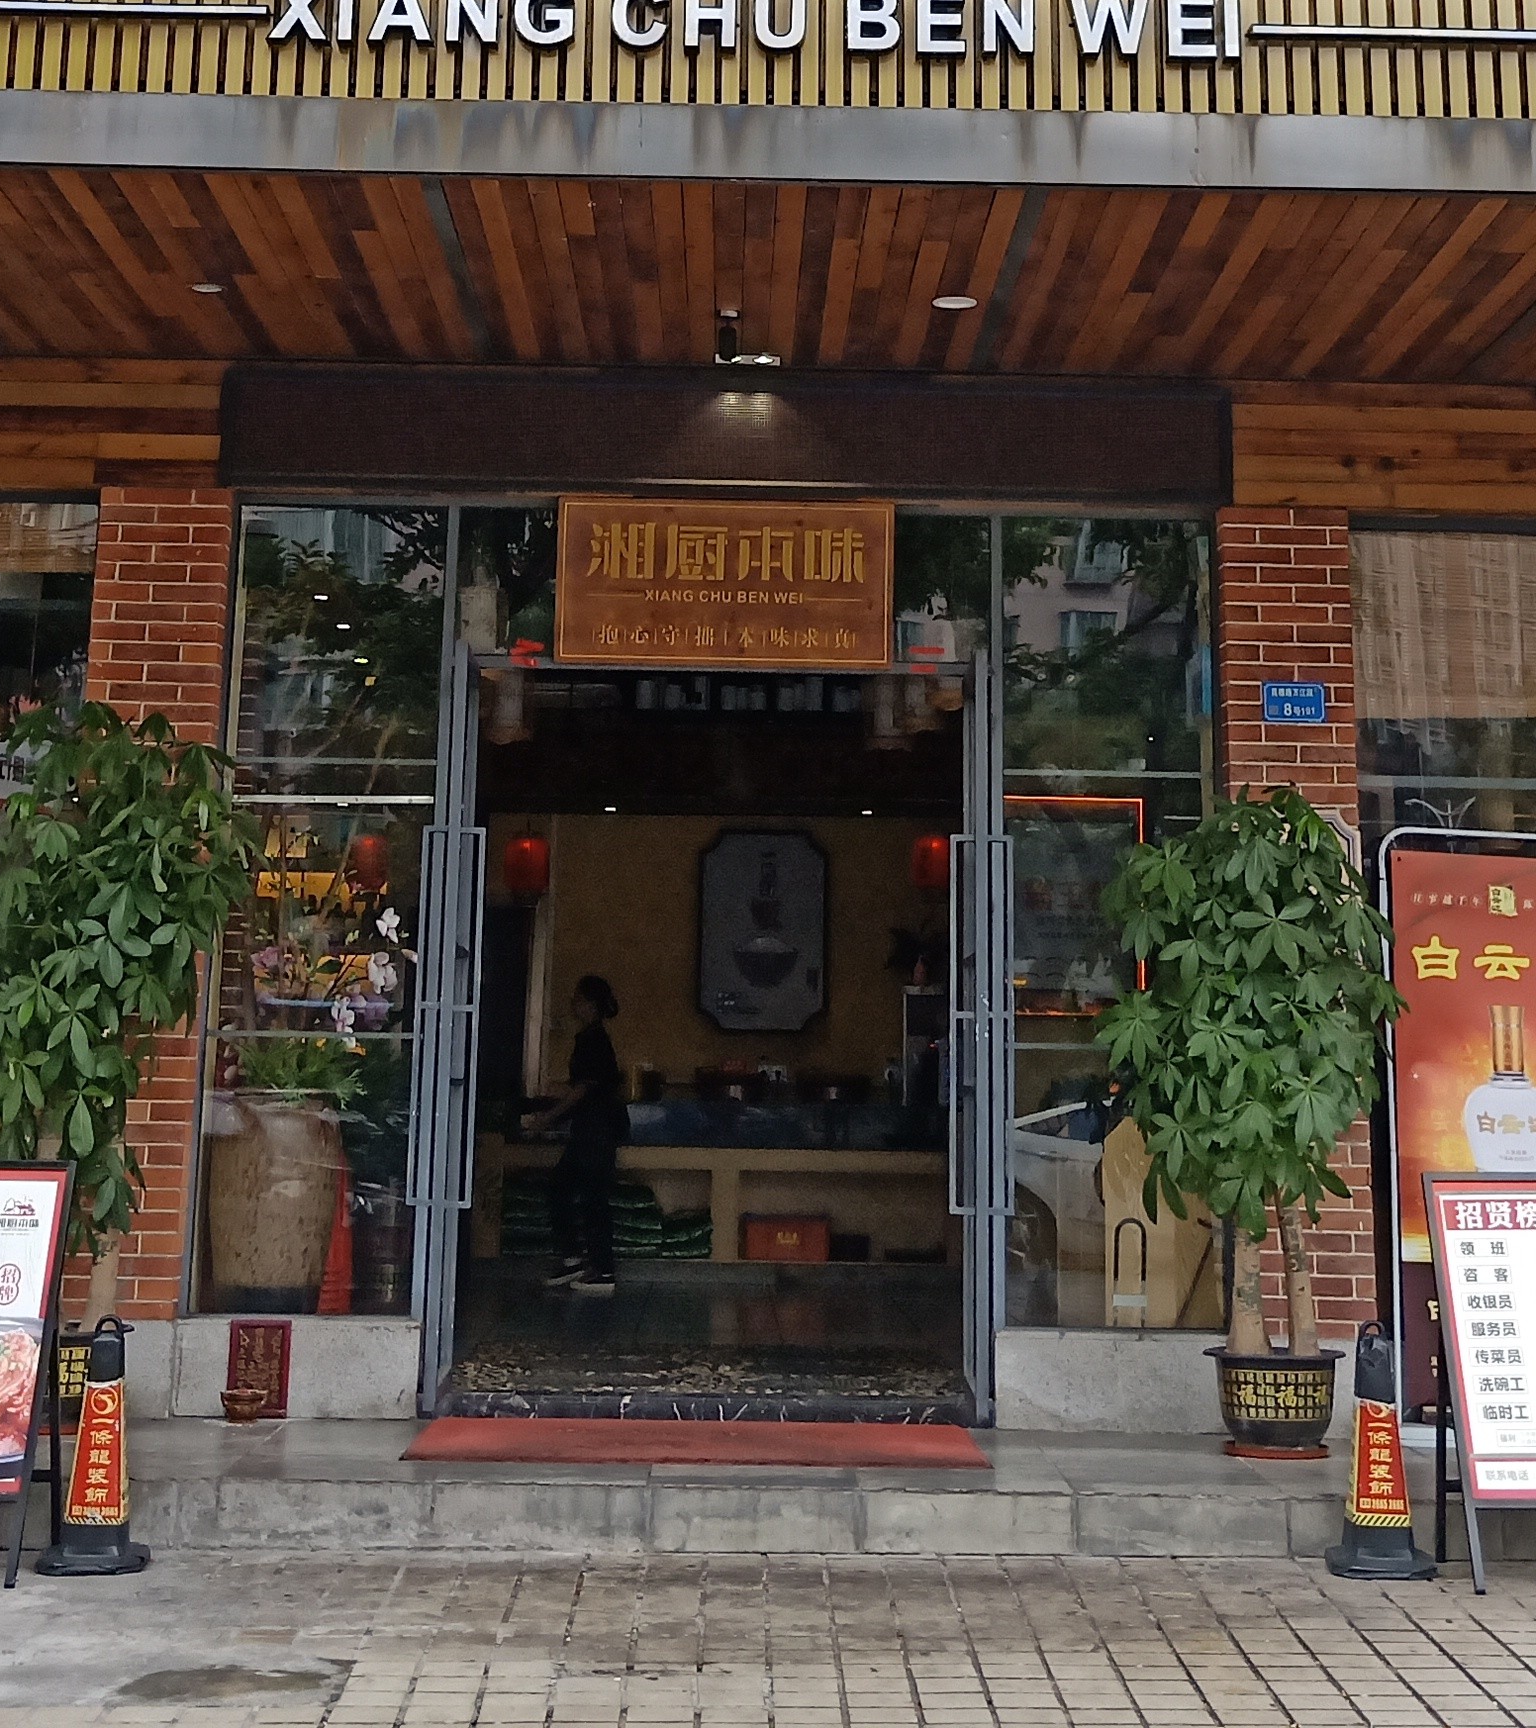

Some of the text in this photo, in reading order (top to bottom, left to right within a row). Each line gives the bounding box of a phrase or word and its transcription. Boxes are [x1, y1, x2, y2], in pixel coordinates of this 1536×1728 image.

[586, 522, 865, 583] 湘厨本味
[644, 589, 804, 605] XIANG CHU BEN WEI
[1467, 1294, 1513, 1309] 收银员
[1471, 1321, 1517, 1337] 服务员
[1475, 1349, 1522, 1364] 传菜员
[1478, 1376, 1525, 1392] 洗碗工
[1482, 1405, 1530, 1420] 临时工
